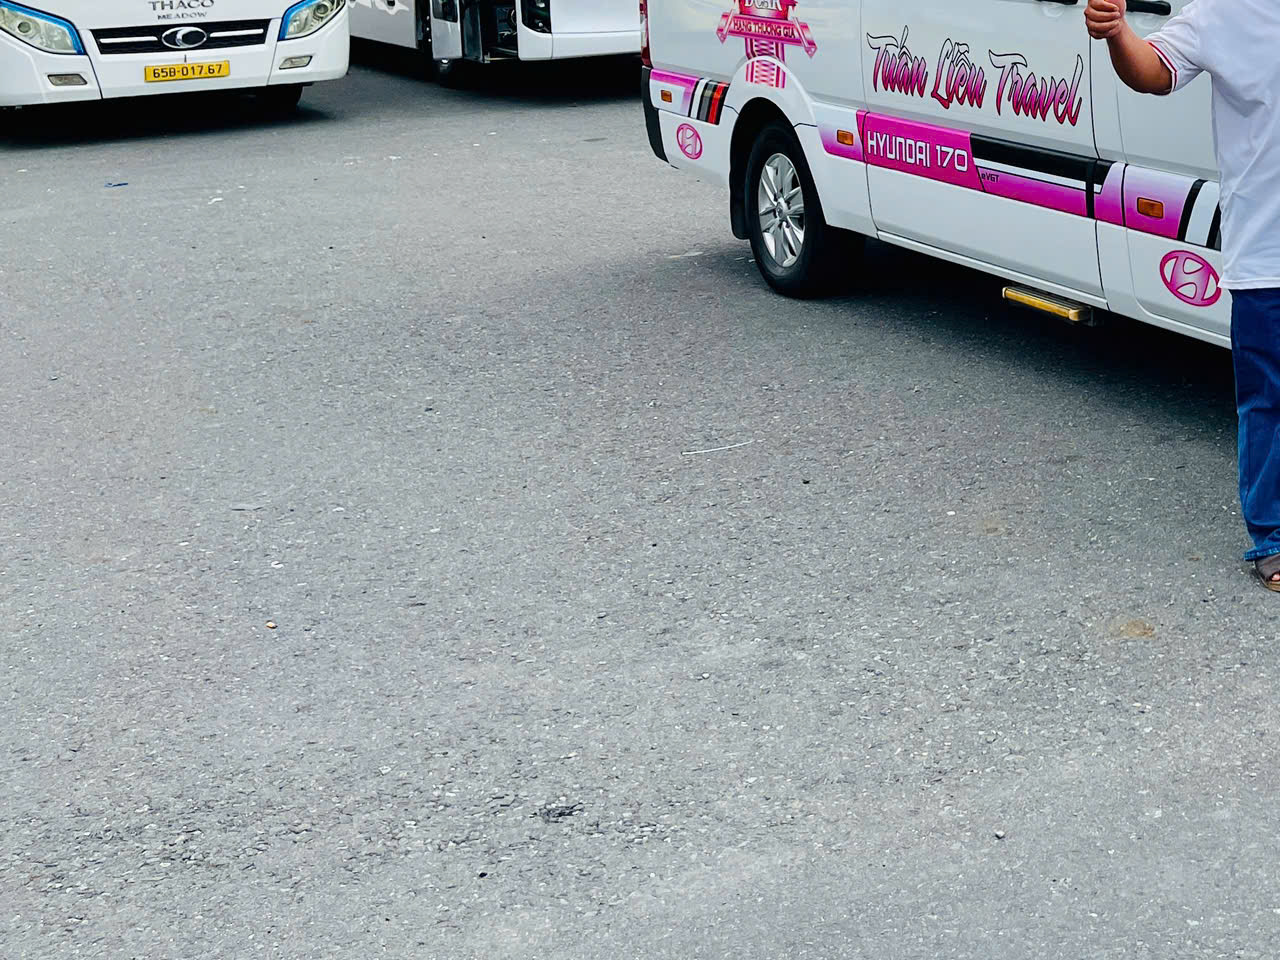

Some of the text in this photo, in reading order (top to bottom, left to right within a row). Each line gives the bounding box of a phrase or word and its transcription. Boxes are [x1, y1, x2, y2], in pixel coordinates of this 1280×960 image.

[157, 12, 207, 20] MEADOW
[153, 64, 222, 79] 65B-017.67
[866, 25, 928, 98] Tuấn
[989, 49, 1083, 126] Travel
[867, 130, 968, 172] HYUNDAI 170
